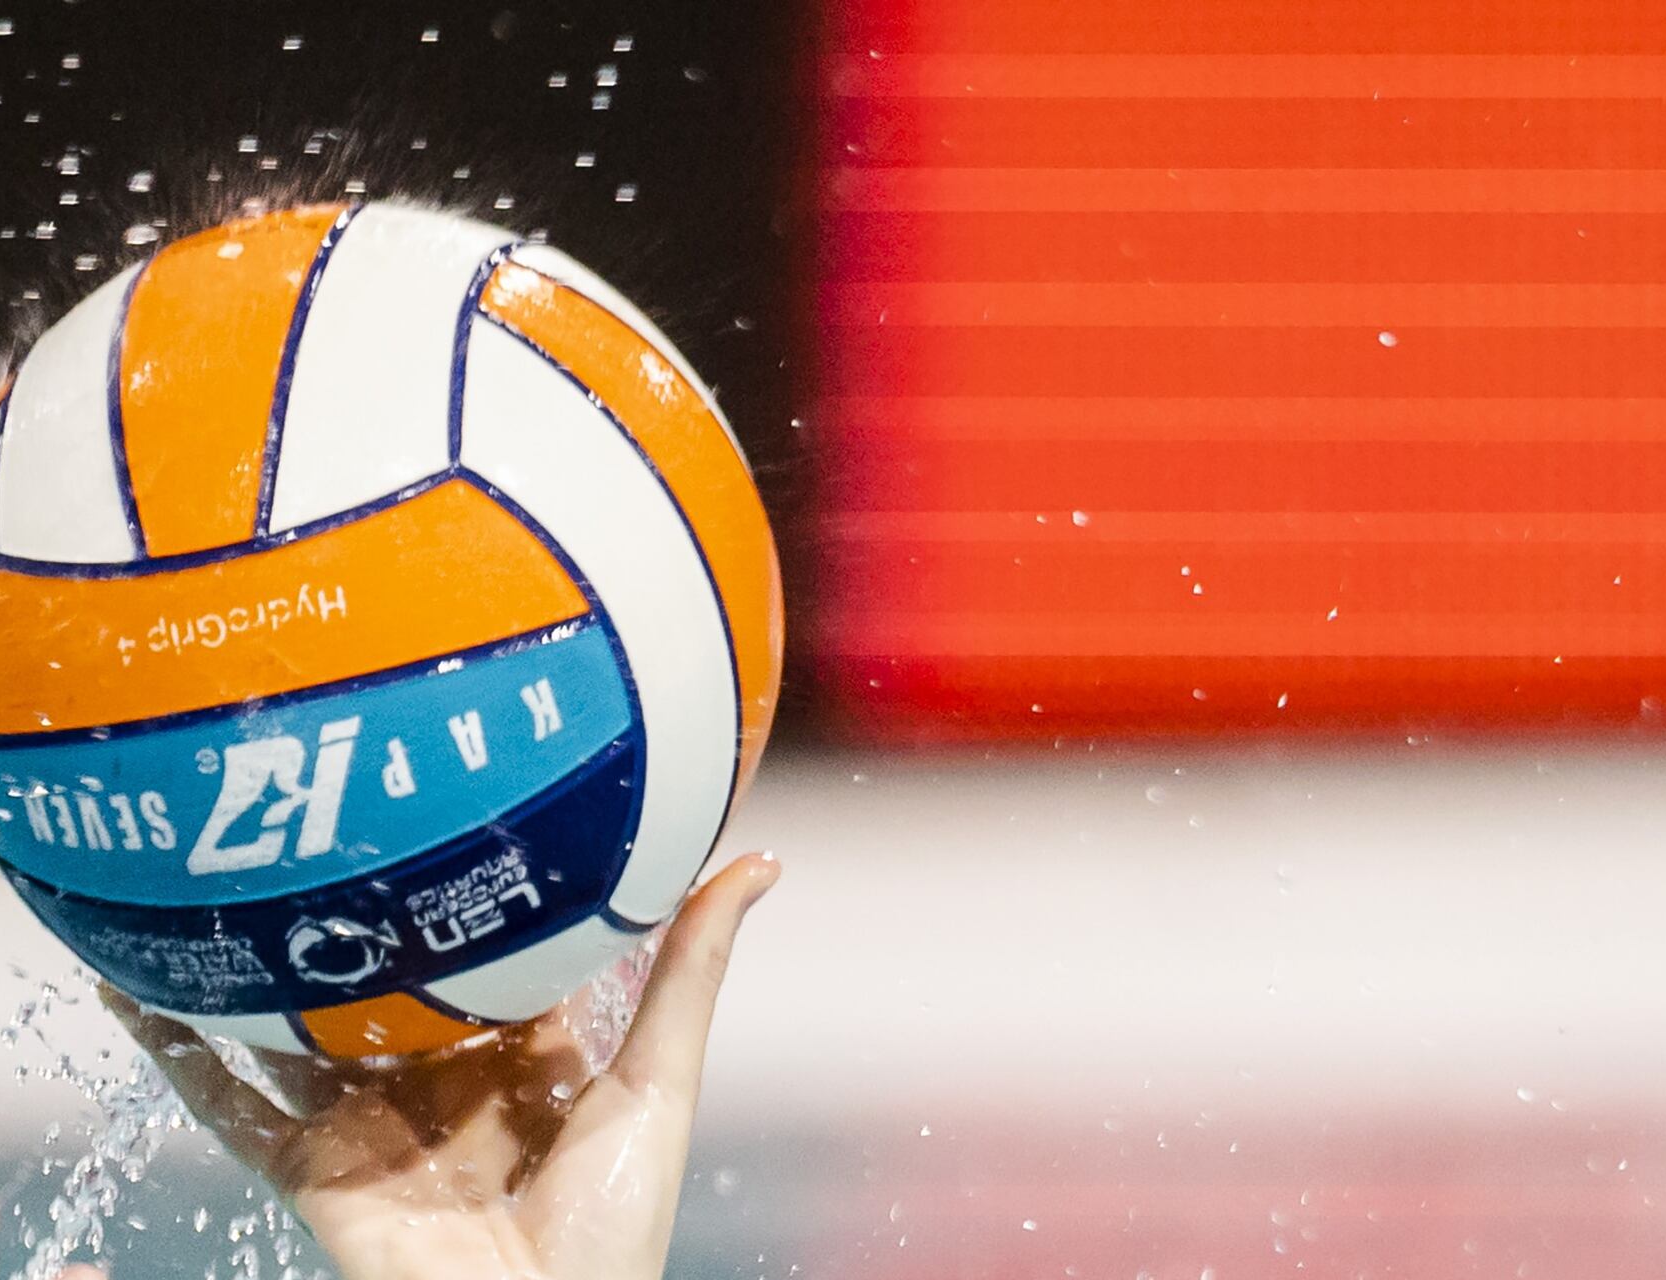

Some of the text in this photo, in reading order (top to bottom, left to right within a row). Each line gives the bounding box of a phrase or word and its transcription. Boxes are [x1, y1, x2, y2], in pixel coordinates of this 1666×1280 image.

[116, 584, 347, 666] HydroGrip 4
[25, 790, 178, 852] SEVEN
[421, 883, 541, 953] LEN
